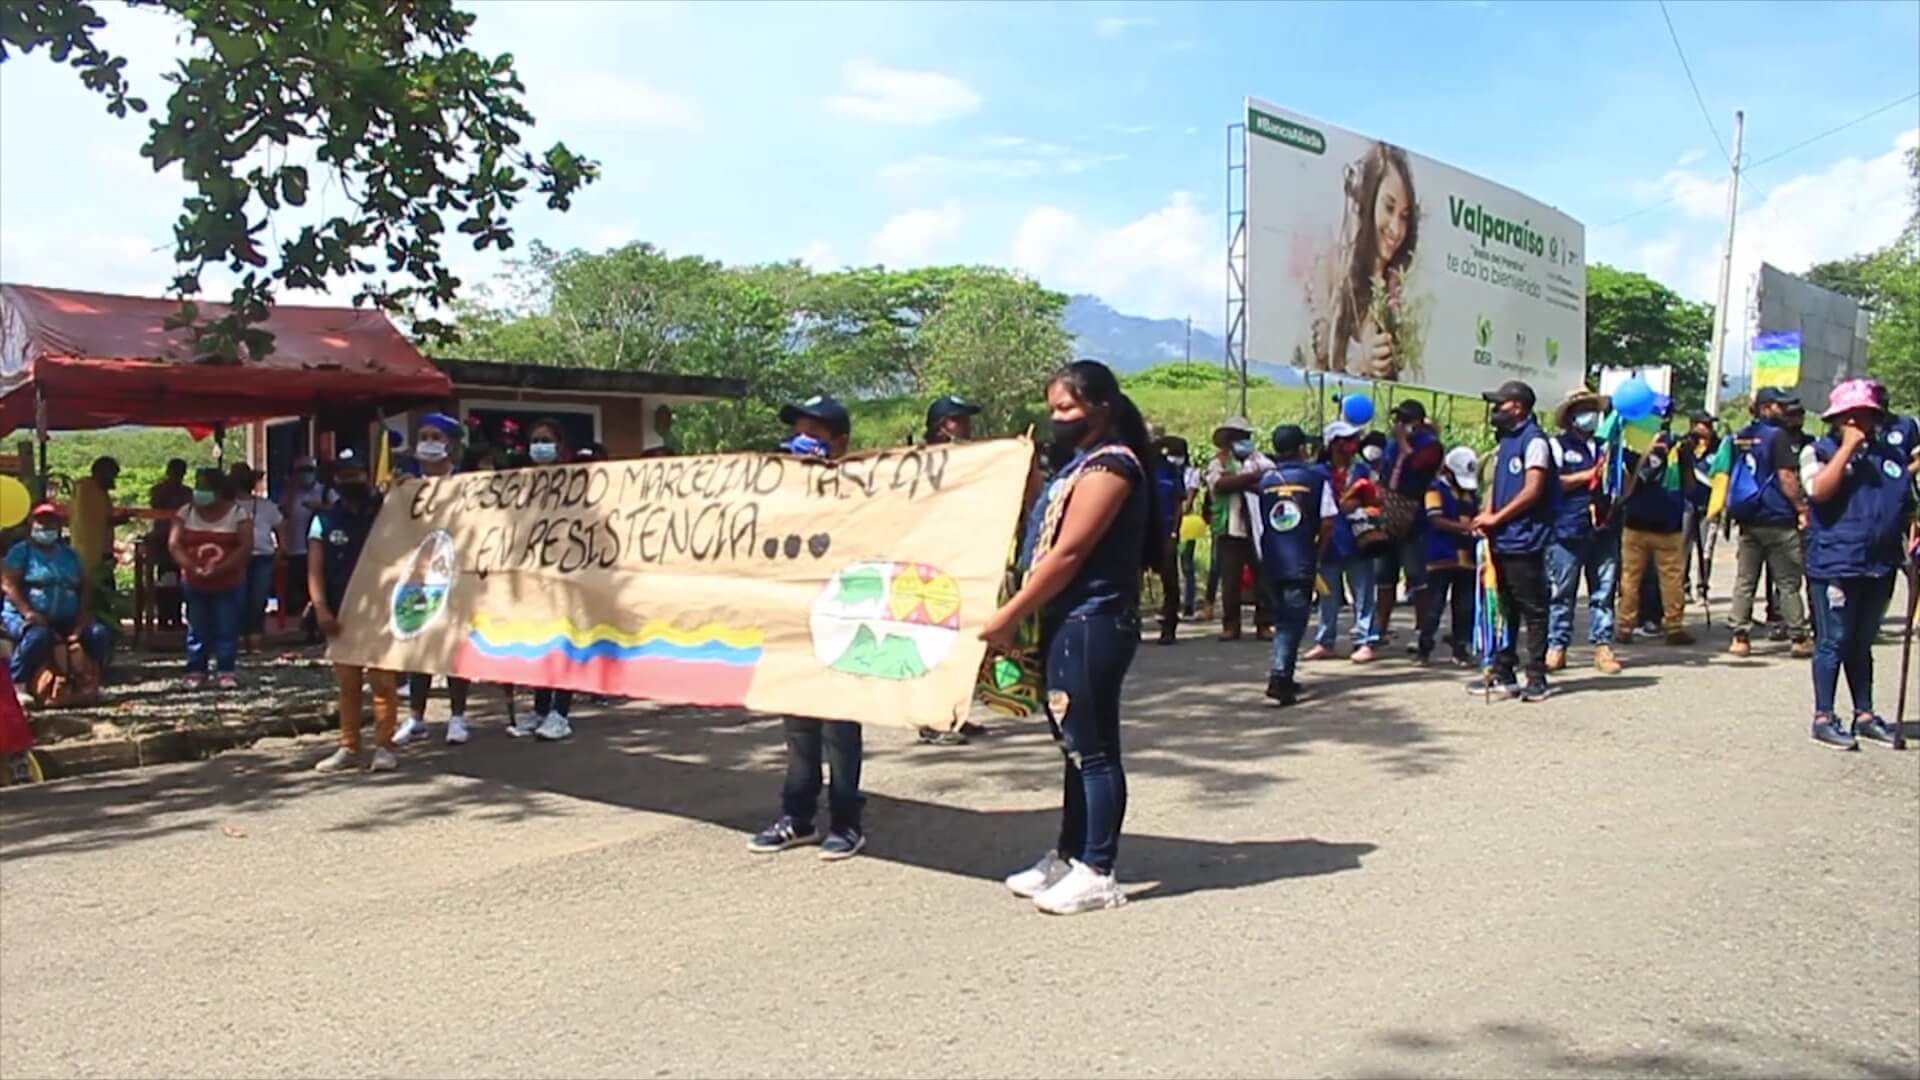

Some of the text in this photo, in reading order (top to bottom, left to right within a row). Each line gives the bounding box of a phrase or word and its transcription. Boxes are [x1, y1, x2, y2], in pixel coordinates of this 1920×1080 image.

[1449, 195, 1544, 257] Valparaíso
[1447, 253, 1459, 272] te
[1461, 256, 1477, 278] da
[1479, 262, 1489, 282] la
[410, 480, 441, 520] EL
[618, 456, 785, 501] MARCELINO
[476, 521, 517, 579] EN
